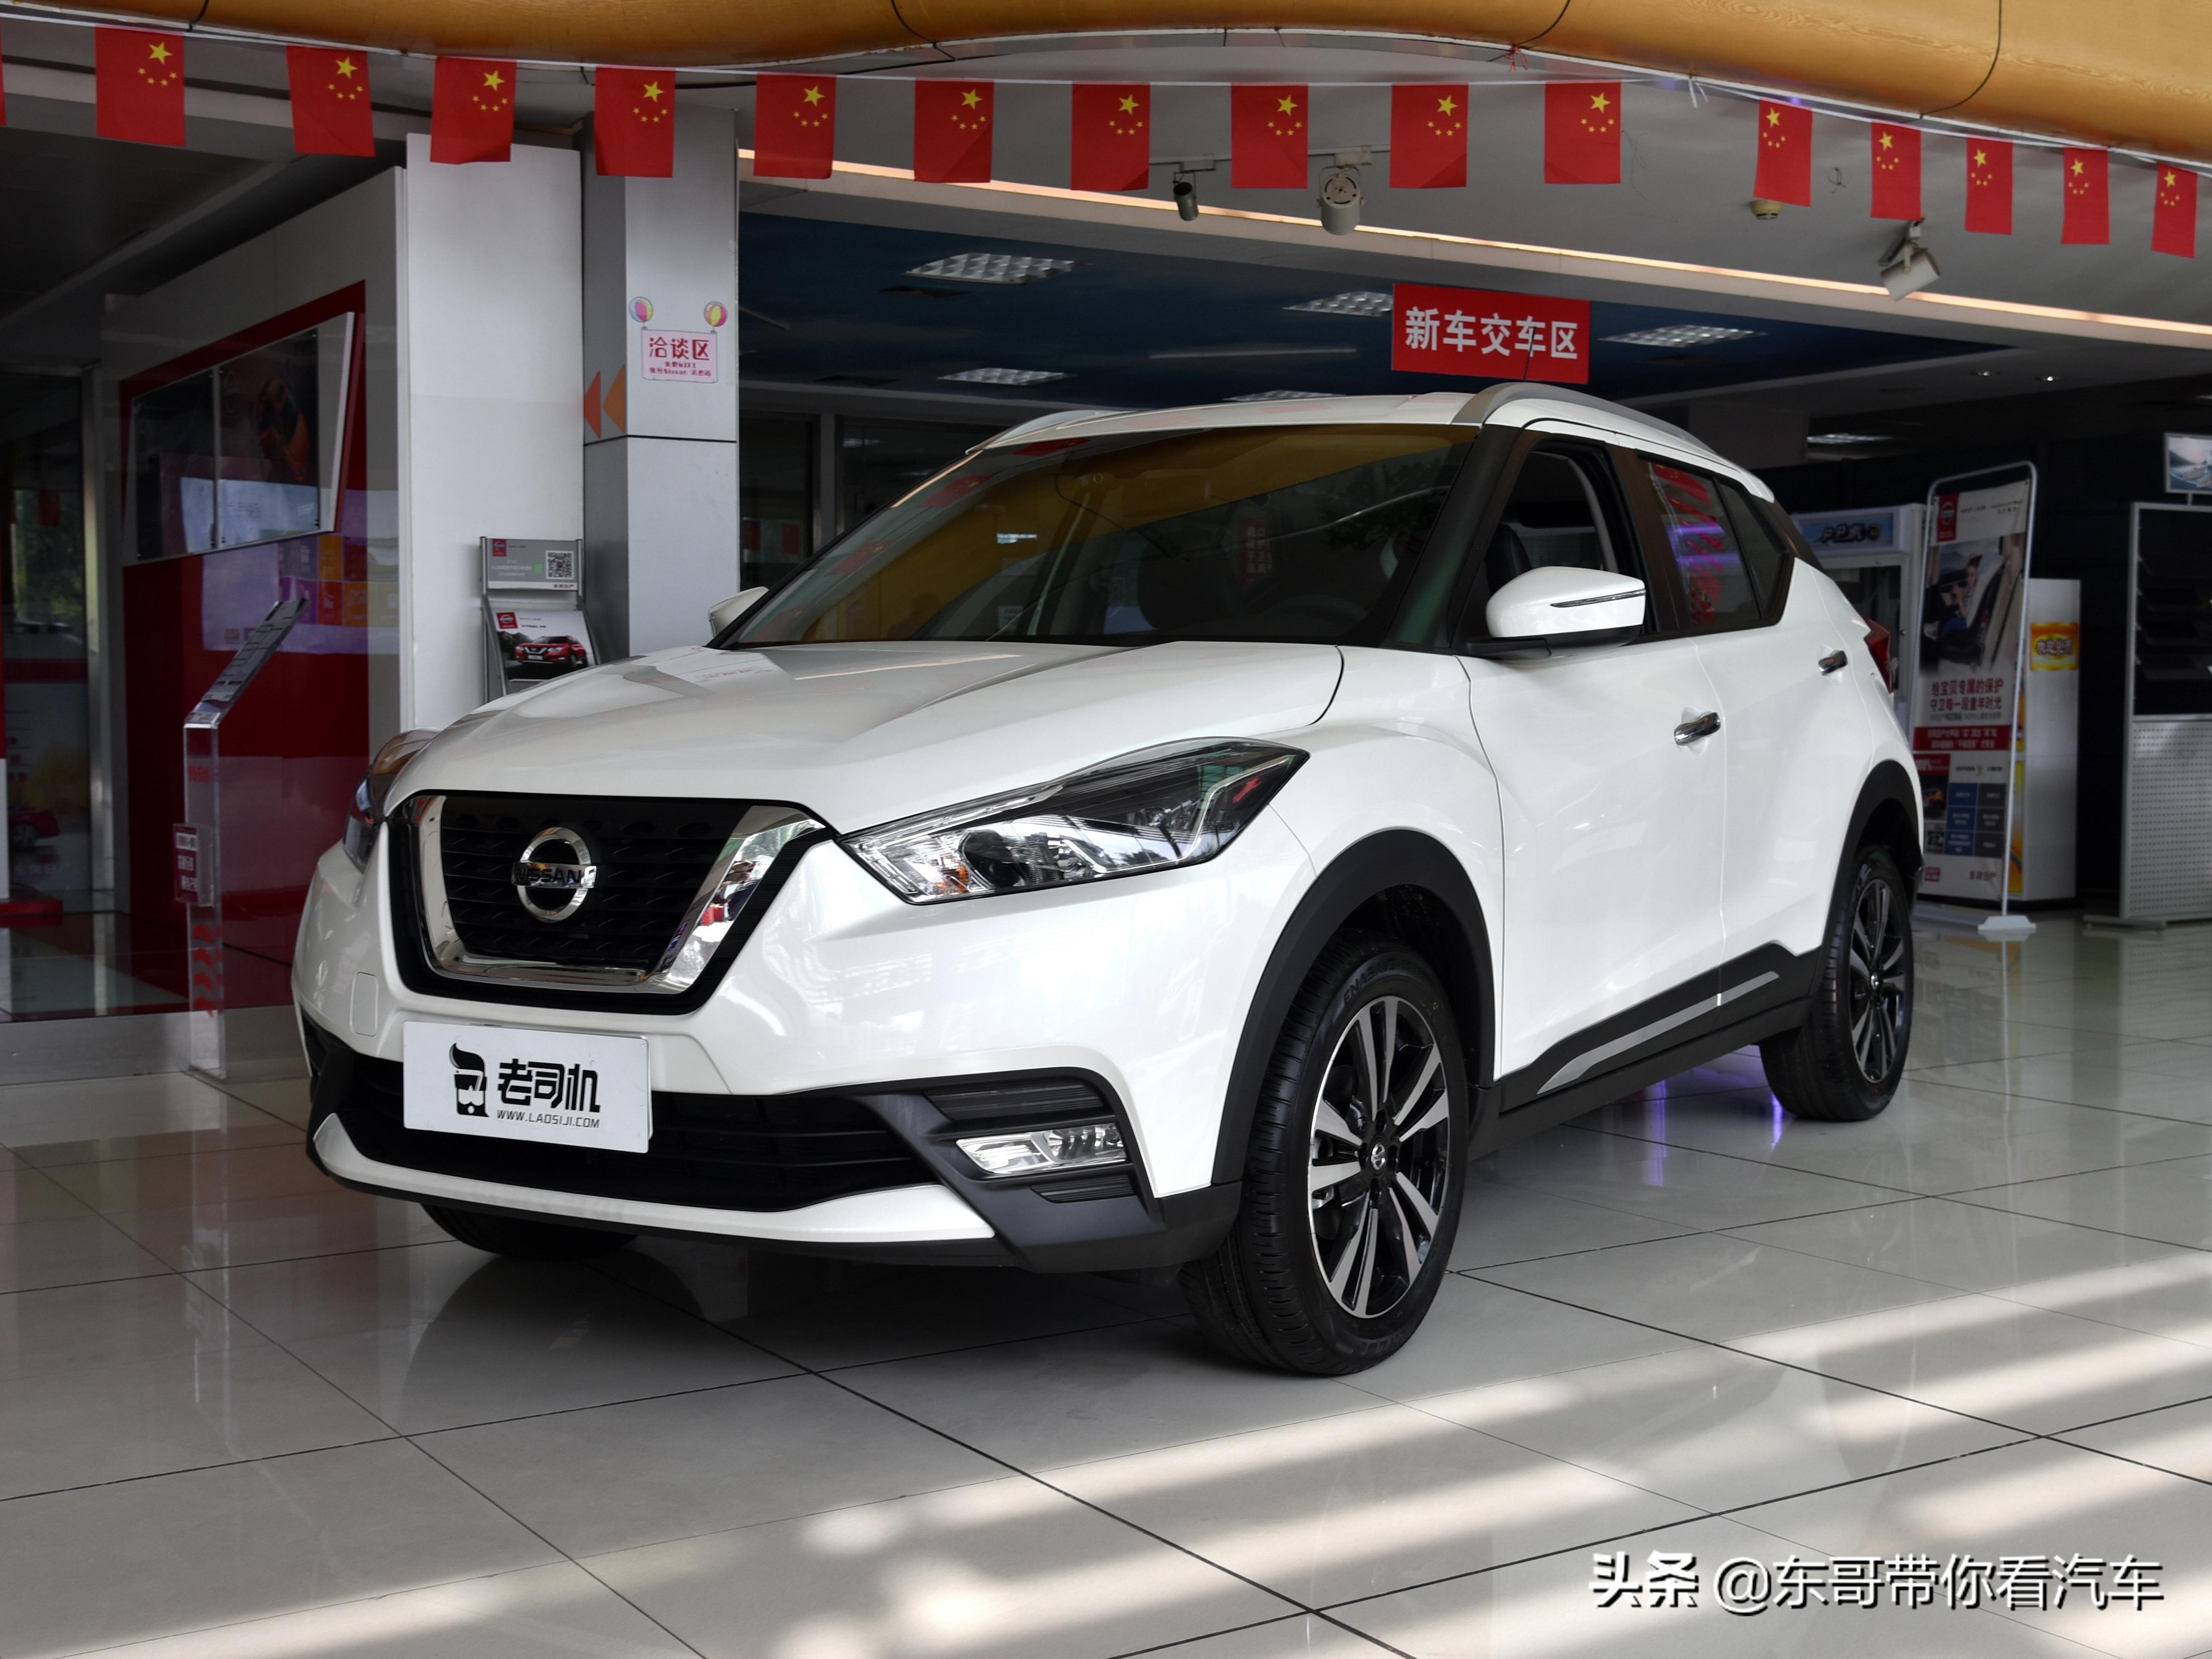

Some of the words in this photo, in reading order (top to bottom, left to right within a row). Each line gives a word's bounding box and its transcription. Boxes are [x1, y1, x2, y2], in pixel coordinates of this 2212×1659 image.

[1405, 306, 1578, 359] 新车交车区
[649, 336, 710, 360] 洽谈区
[514, 865, 582, 886] NISSAN
[497, 1058, 601, 1113] 老司机
[497, 1109, 600, 1129] WWW.LAOSIJI.COM
